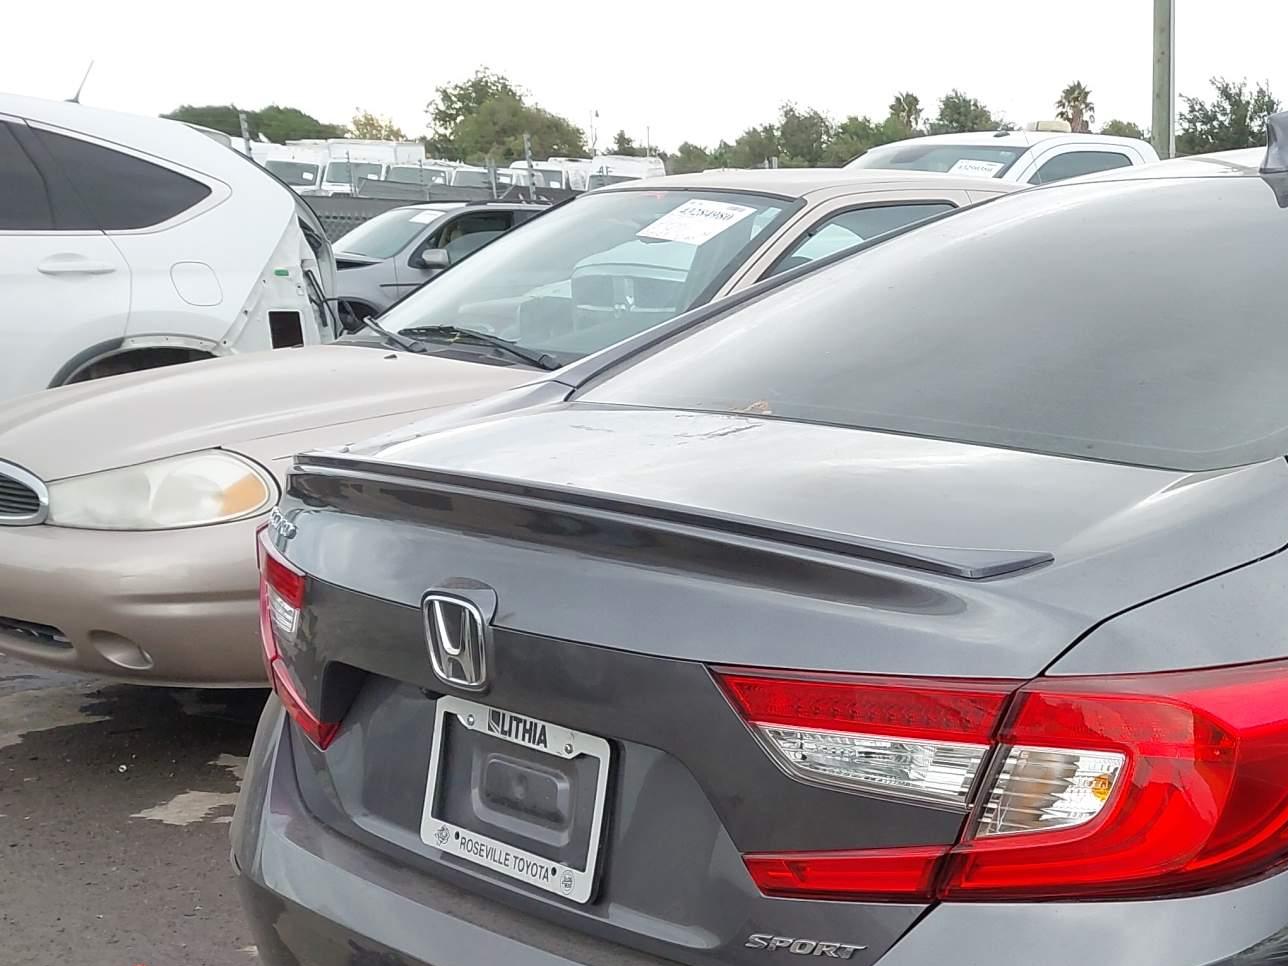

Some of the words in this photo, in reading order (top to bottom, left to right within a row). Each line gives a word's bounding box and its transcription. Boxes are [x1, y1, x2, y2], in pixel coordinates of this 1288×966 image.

[500, 713, 548, 748] LITHIA
[459, 836, 511, 867] ROSEVILLE
[513, 855, 549, 882] TOYOTA
[744, 933, 868, 960] SPORT
